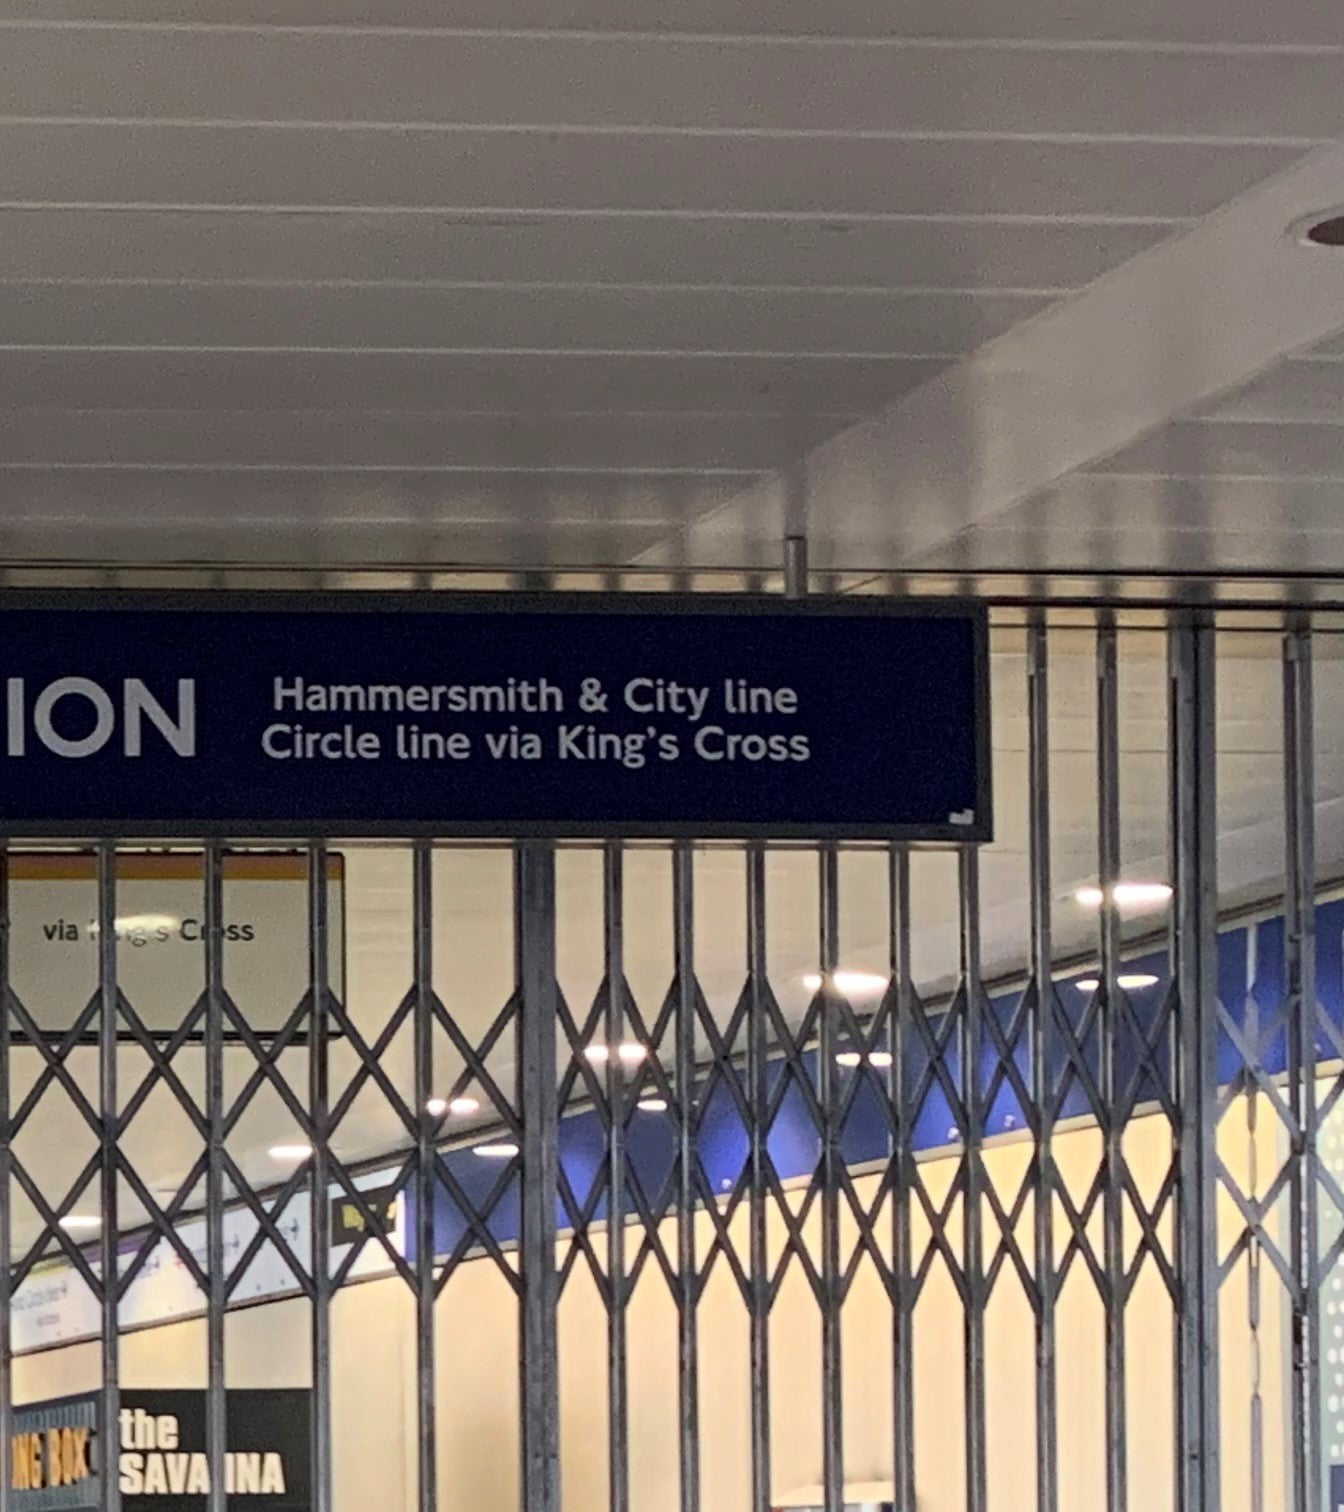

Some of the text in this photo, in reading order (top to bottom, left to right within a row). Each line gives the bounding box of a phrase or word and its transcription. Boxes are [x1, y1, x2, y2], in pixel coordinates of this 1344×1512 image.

[272, 676, 799, 721] Hammersmith & City line
[260, 723, 811, 768] Circle line via King's Cross
[43, 918, 79, 942] via
[179, 918, 255, 942] Css
[118, 1408, 179, 1450] the
[118, 1452, 286, 1495] SAVANA
